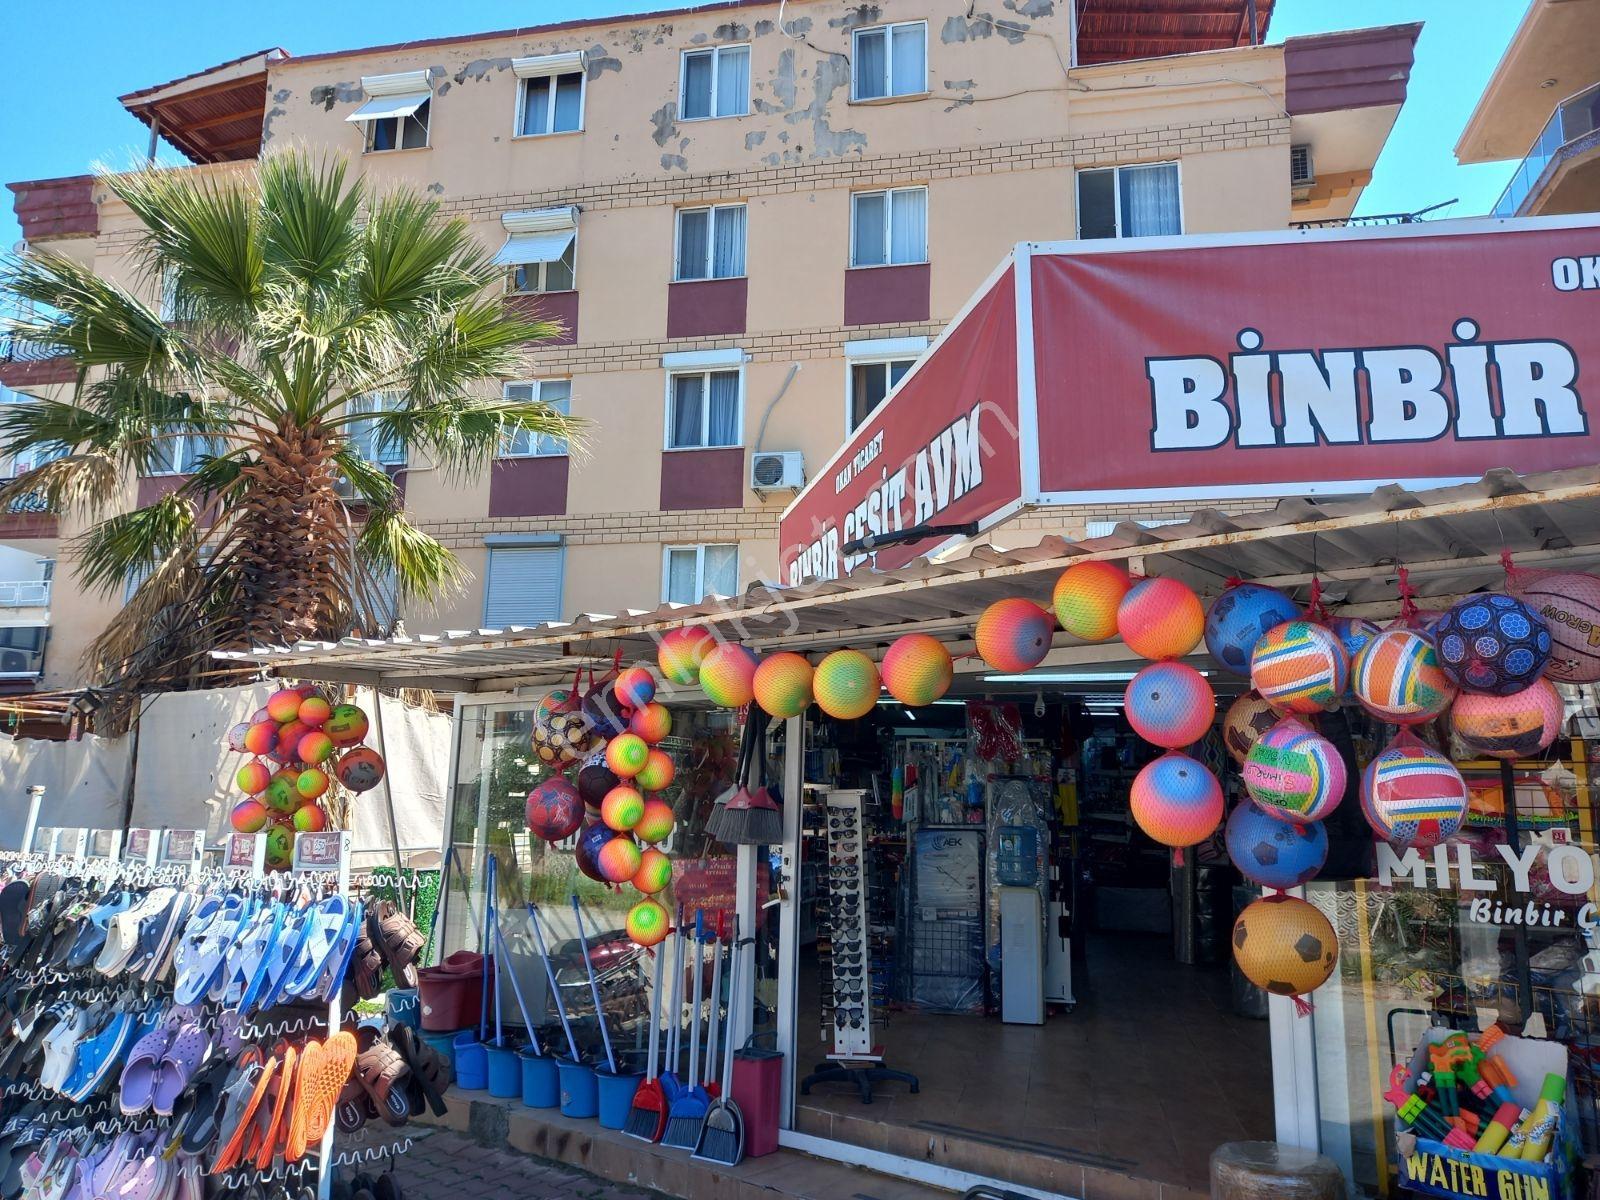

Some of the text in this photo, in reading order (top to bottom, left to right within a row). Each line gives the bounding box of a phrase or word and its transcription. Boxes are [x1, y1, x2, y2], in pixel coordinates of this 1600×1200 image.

[1144, 317, 1590, 453] BİNBİR
[914, 400, 983, 527] AVM
[1469, 897, 1567, 928] Binbir
[1406, 1151, 1550, 1200] WATER GUN
